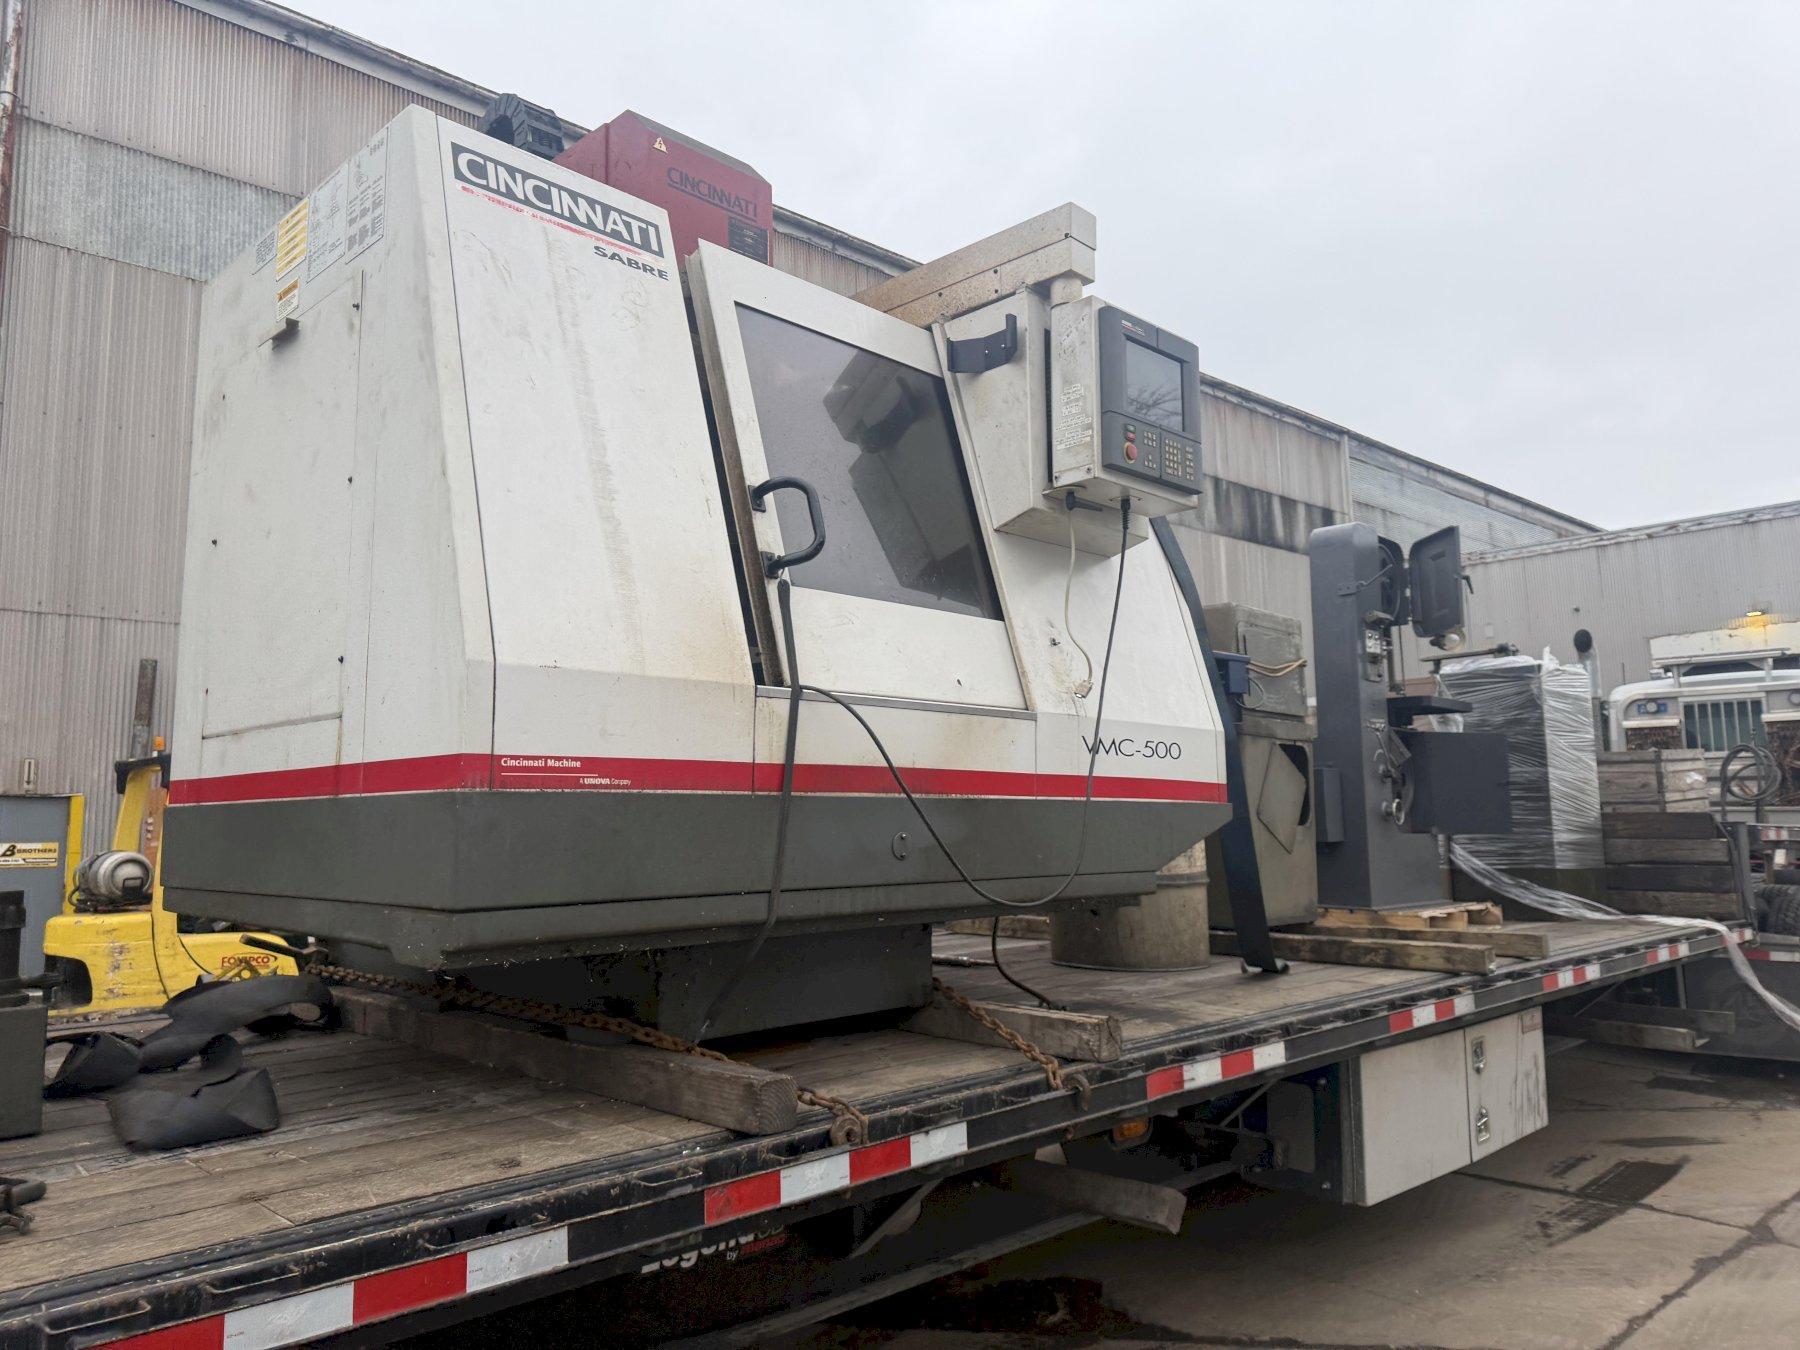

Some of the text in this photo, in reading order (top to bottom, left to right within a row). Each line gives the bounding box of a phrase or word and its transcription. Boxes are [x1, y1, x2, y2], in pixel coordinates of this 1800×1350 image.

[457, 152, 660, 252] CINCINNATI
[667, 166, 758, 219] CINCINNATI
[593, 245, 670, 282] SABRE
[501, 757, 581, 768] Cincinnati Machine
[1081, 735, 1182, 760] VMC-500
[584, 777, 611, 785] UNOVA
